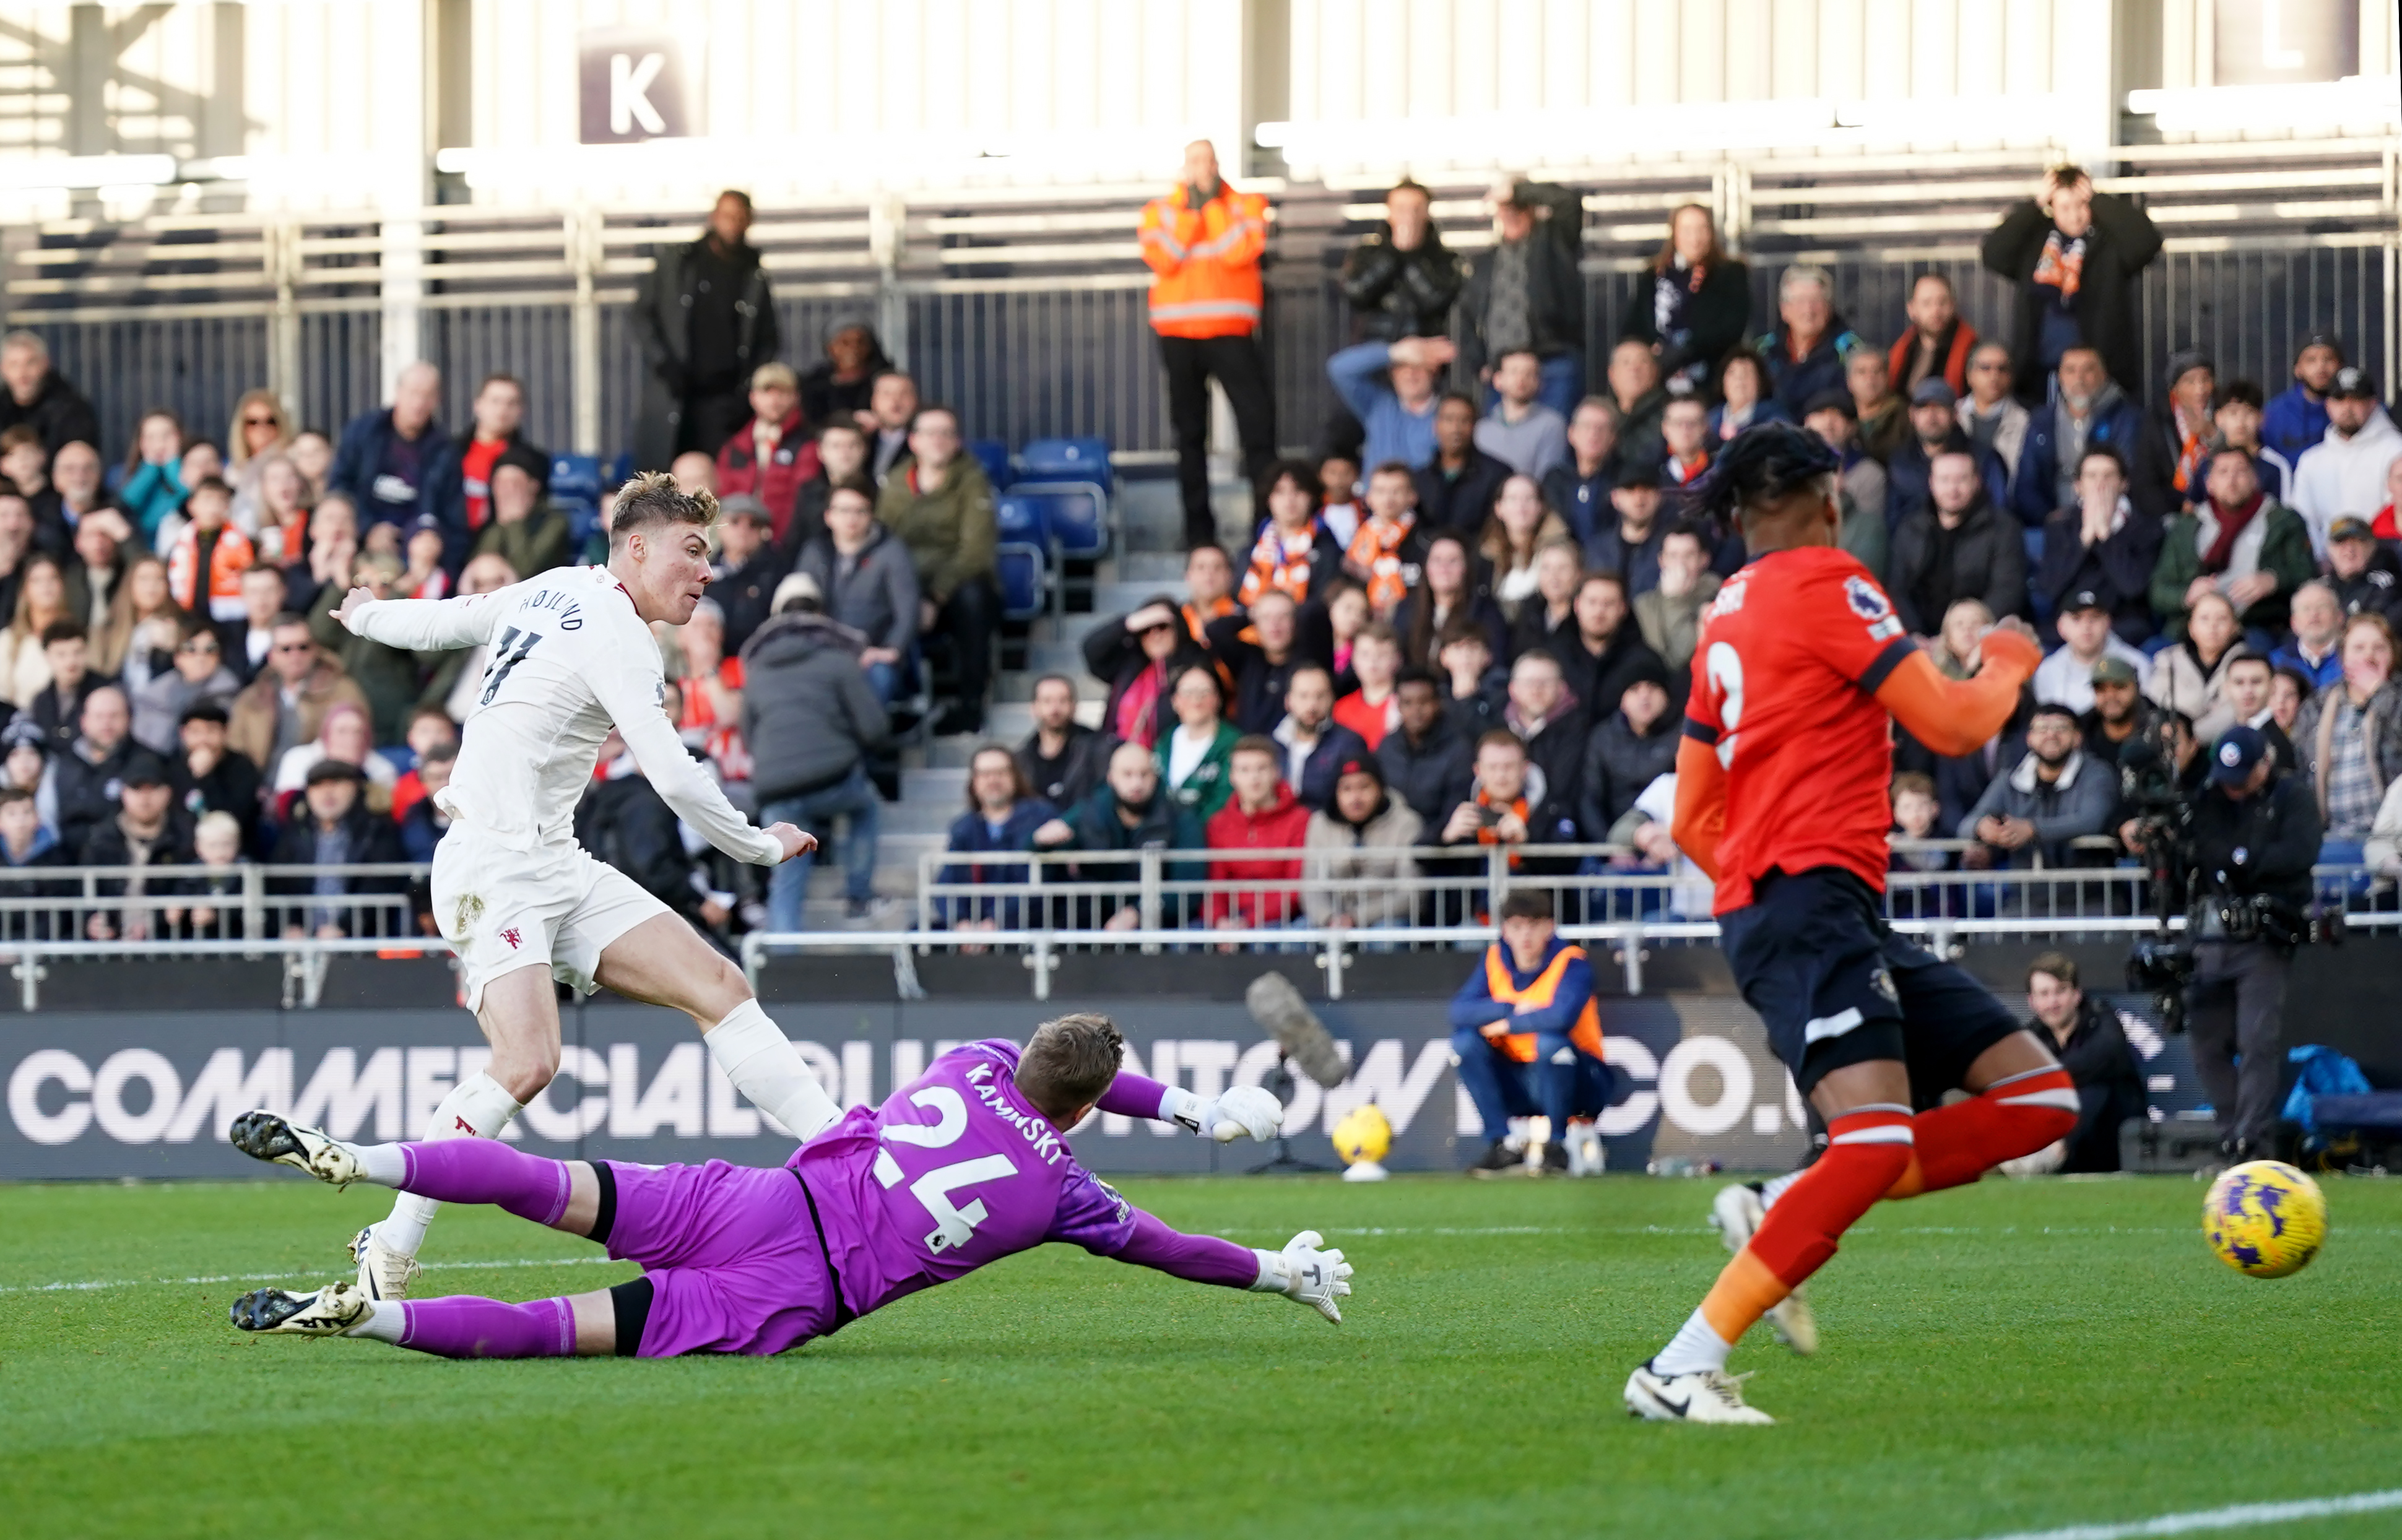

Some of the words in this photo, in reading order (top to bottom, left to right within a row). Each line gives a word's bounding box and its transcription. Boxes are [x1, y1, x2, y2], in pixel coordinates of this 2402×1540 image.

[2263, 0, 2305, 69] L
[609, 52, 667, 135] K
[479, 626, 543, 706] 11
[965, 1063, 1062, 1165] KAMINSKI
[872, 1086, 1018, 1255] 24
